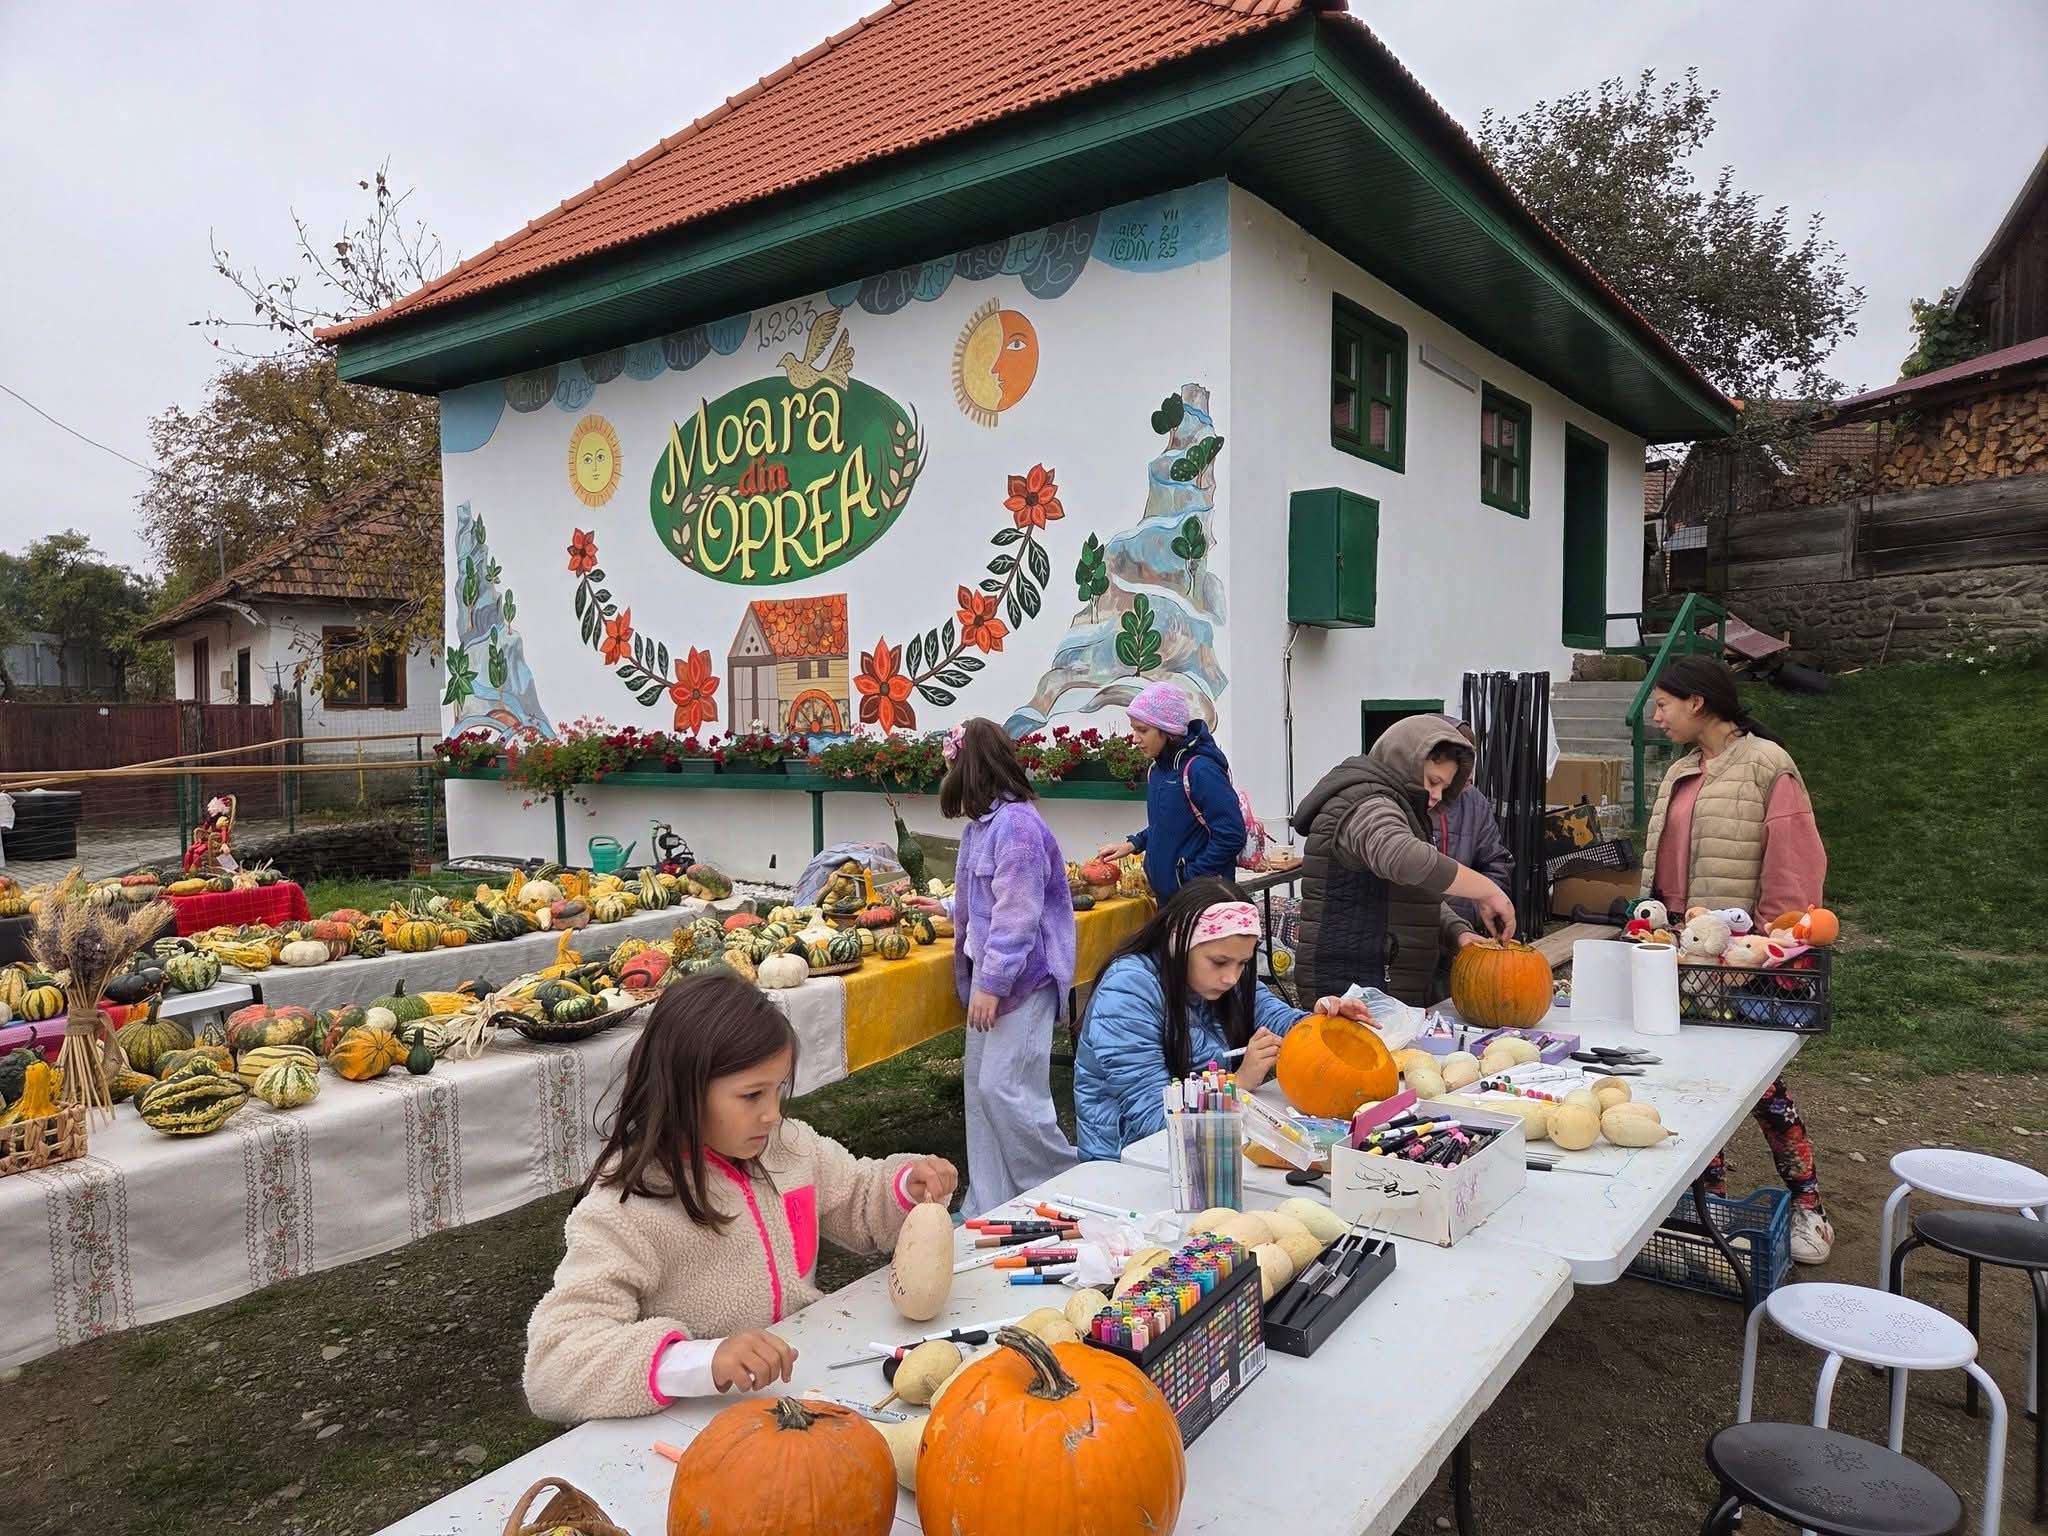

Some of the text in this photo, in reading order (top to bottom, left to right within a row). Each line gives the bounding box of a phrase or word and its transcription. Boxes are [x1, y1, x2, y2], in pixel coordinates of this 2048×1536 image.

[1158, 241, 1178, 260] 25
[754, 301, 818, 352] 1223
[661, 387, 849, 505] Moara
[738, 455, 789, 497] din
[697, 444, 879, 580] OPREA
